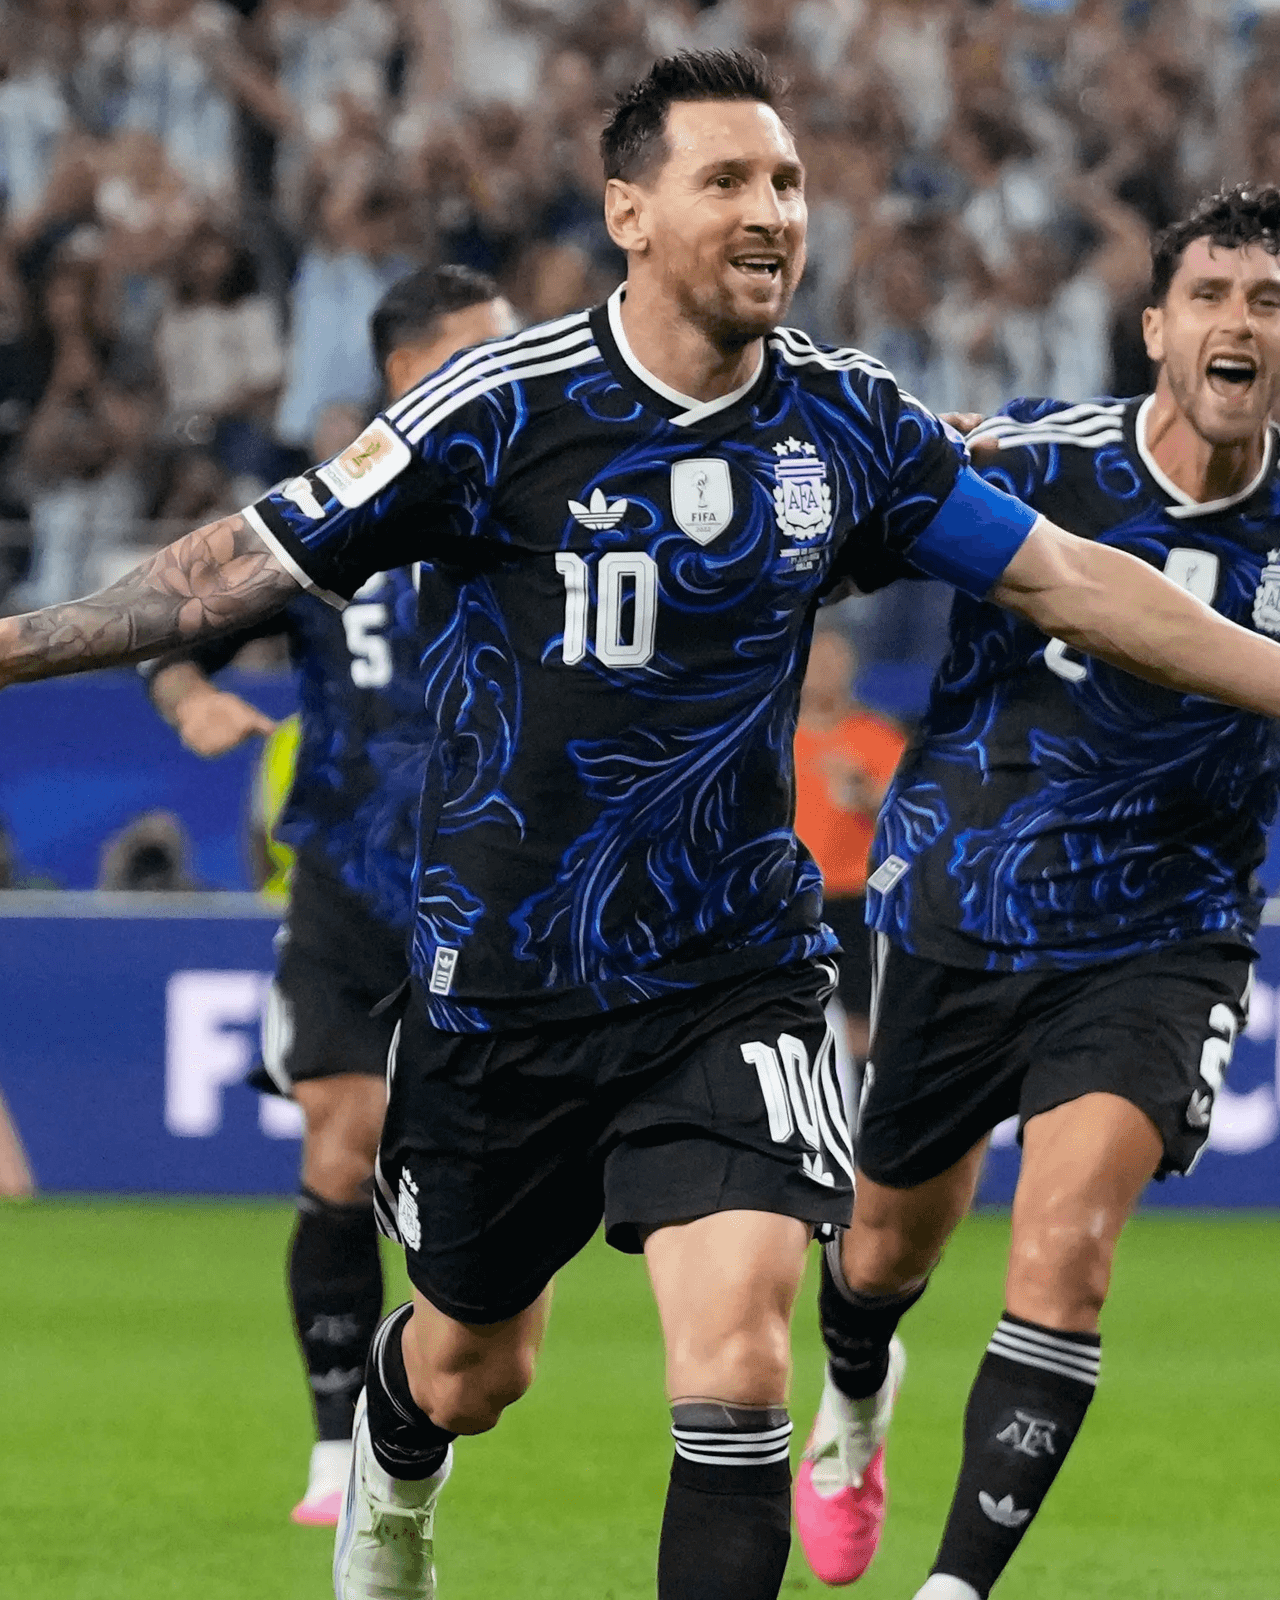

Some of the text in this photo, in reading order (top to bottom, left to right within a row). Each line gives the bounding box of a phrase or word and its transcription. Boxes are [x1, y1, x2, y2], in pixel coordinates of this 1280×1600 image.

[691, 512, 717, 522] FIFA
[342, 603, 392, 688] 5
[555, 551, 658, 668] 10
[740, 1033, 821, 1152] 10
[1199, 1003, 1237, 1096] 2
